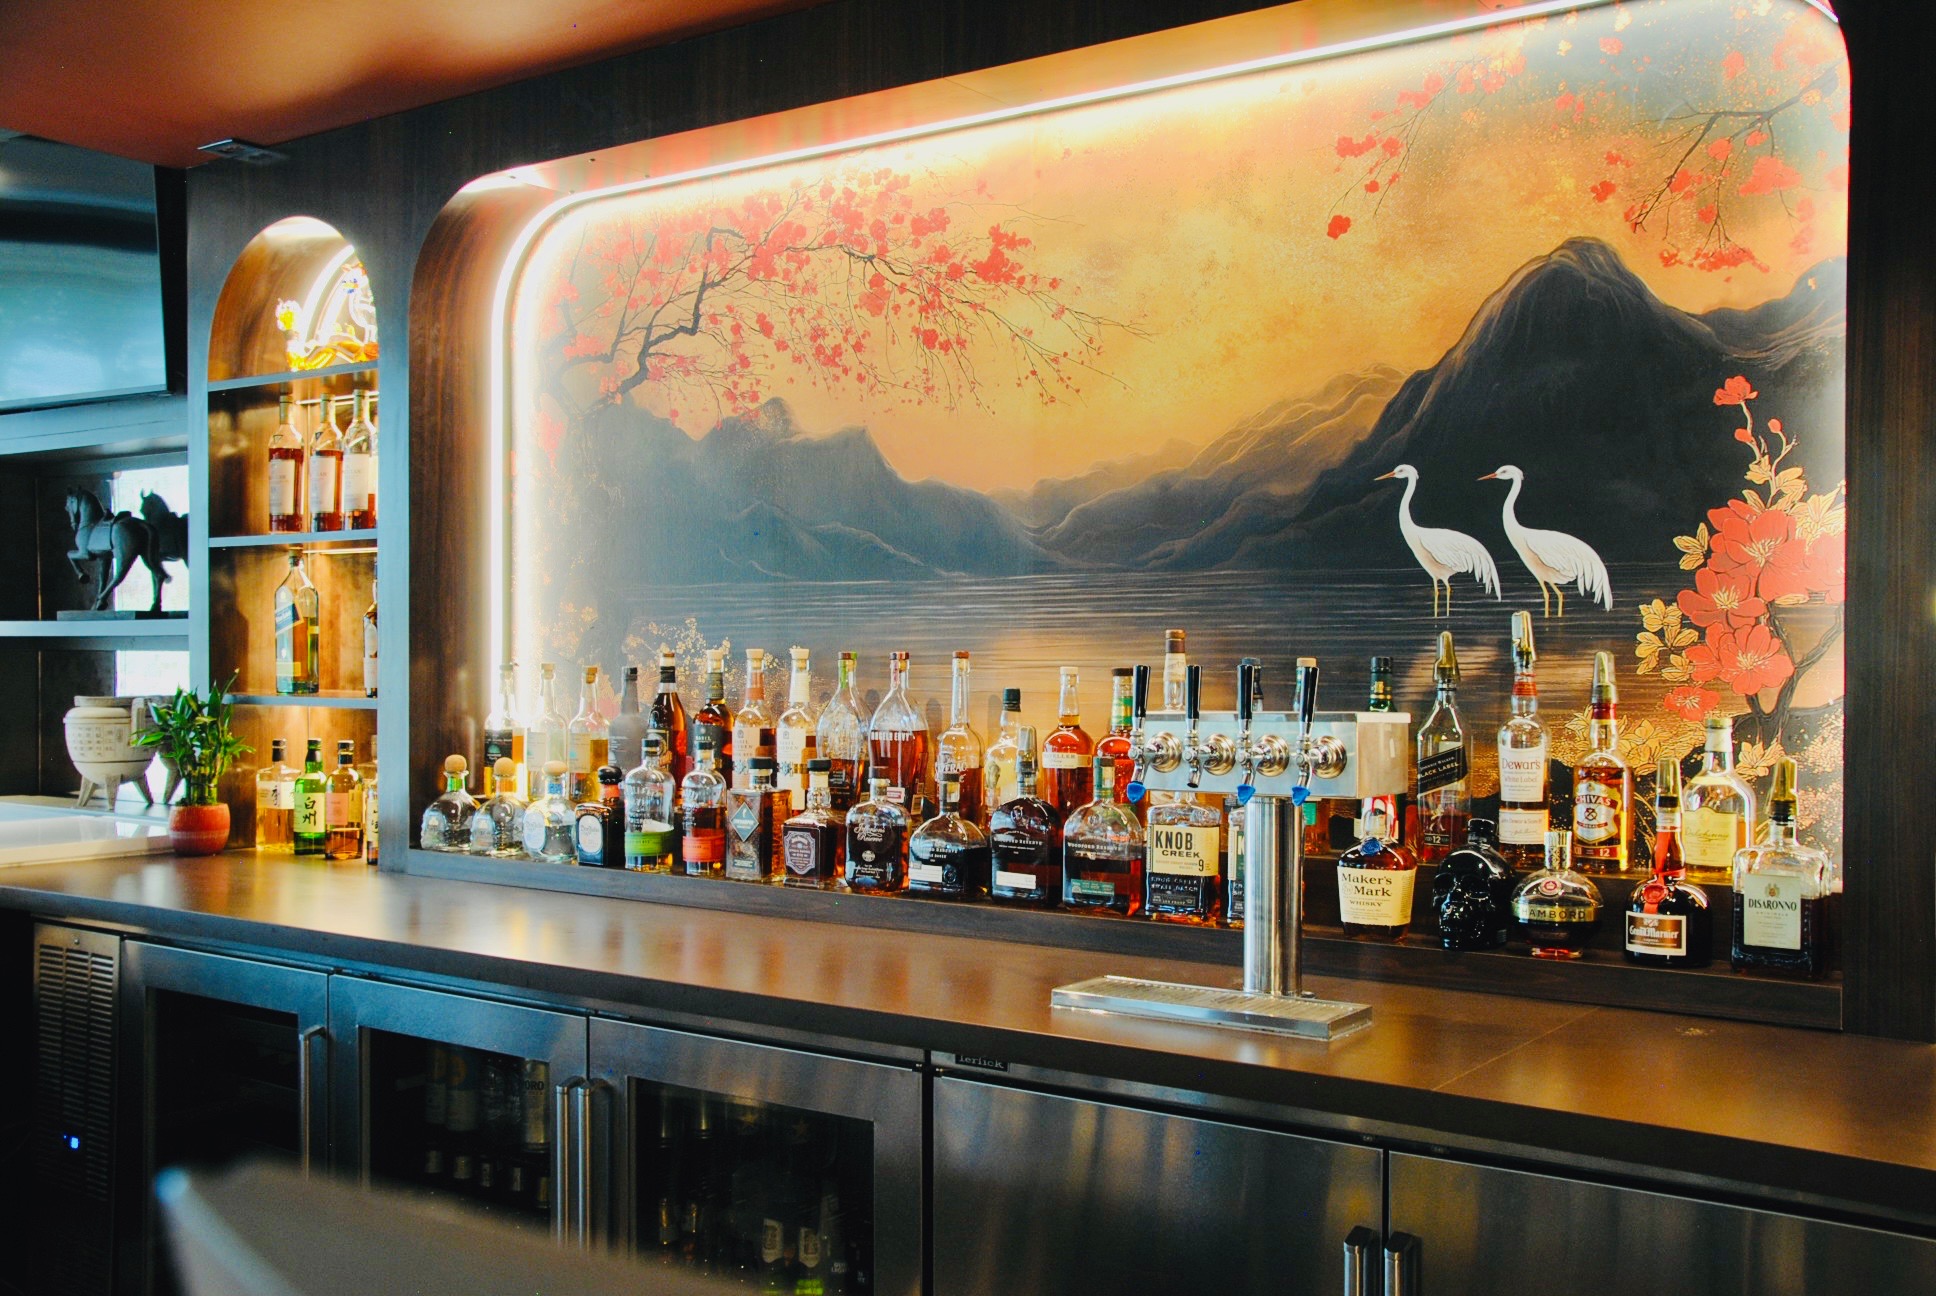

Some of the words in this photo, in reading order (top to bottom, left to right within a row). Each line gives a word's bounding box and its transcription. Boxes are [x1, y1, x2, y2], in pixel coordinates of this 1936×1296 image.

[1438, 761, 1459, 772] LABEL
[1502, 758, 1541, 770] Dewar's
[1575, 795, 1612, 806] CHIVAS
[303, 797, 317, 826] 白州
[1155, 830, 1193, 851] KNOB
[1432, 836, 1441, 844] 12
[1161, 849, 1200, 858] CREEK
[1599, 848, 1610, 857] 12
[1198, 859, 1205, 872] 9
[1341, 873, 1393, 885] Maker's
[1354, 885, 1392, 897] Mark
[1350, 899, 1382, 907] WHISKY
[1748, 898, 1797, 911] DISARONNO
[1521, 908, 1586, 920] HAMBORD
